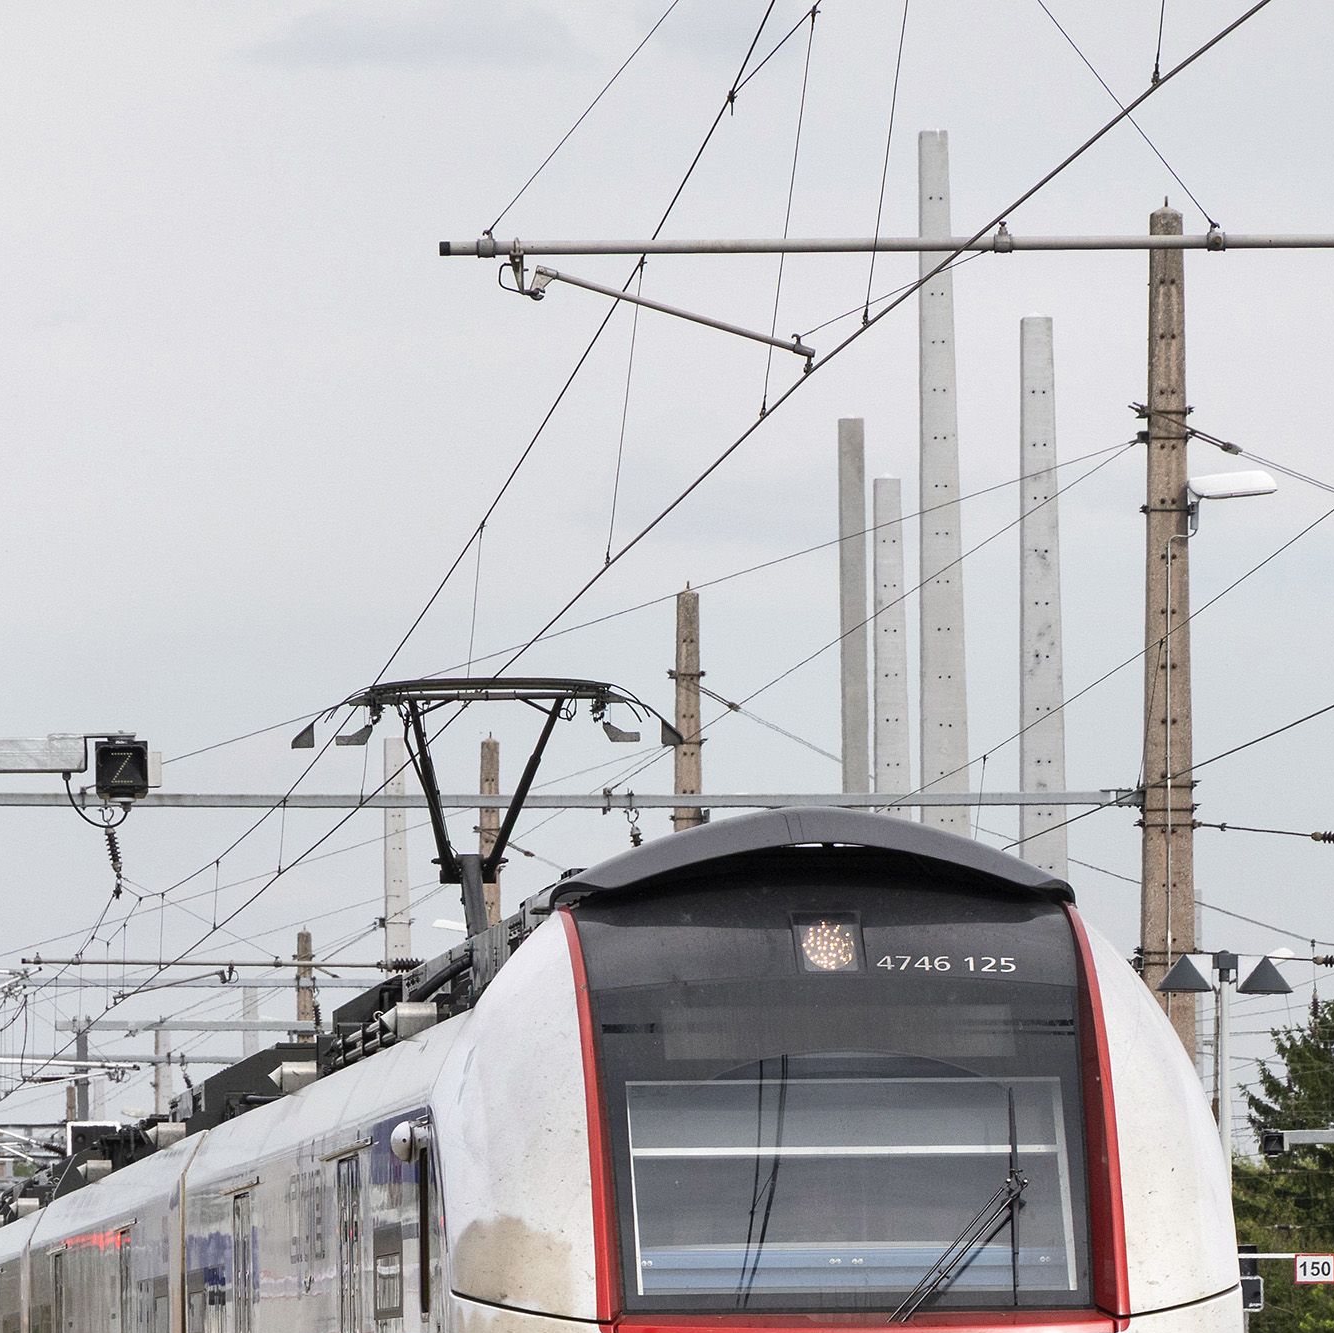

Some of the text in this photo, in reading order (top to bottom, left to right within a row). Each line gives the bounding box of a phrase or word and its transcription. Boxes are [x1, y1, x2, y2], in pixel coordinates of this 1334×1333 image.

[876, 955, 1017, 973] 4746 125
[1299, 1261, 1331, 1277] 150
